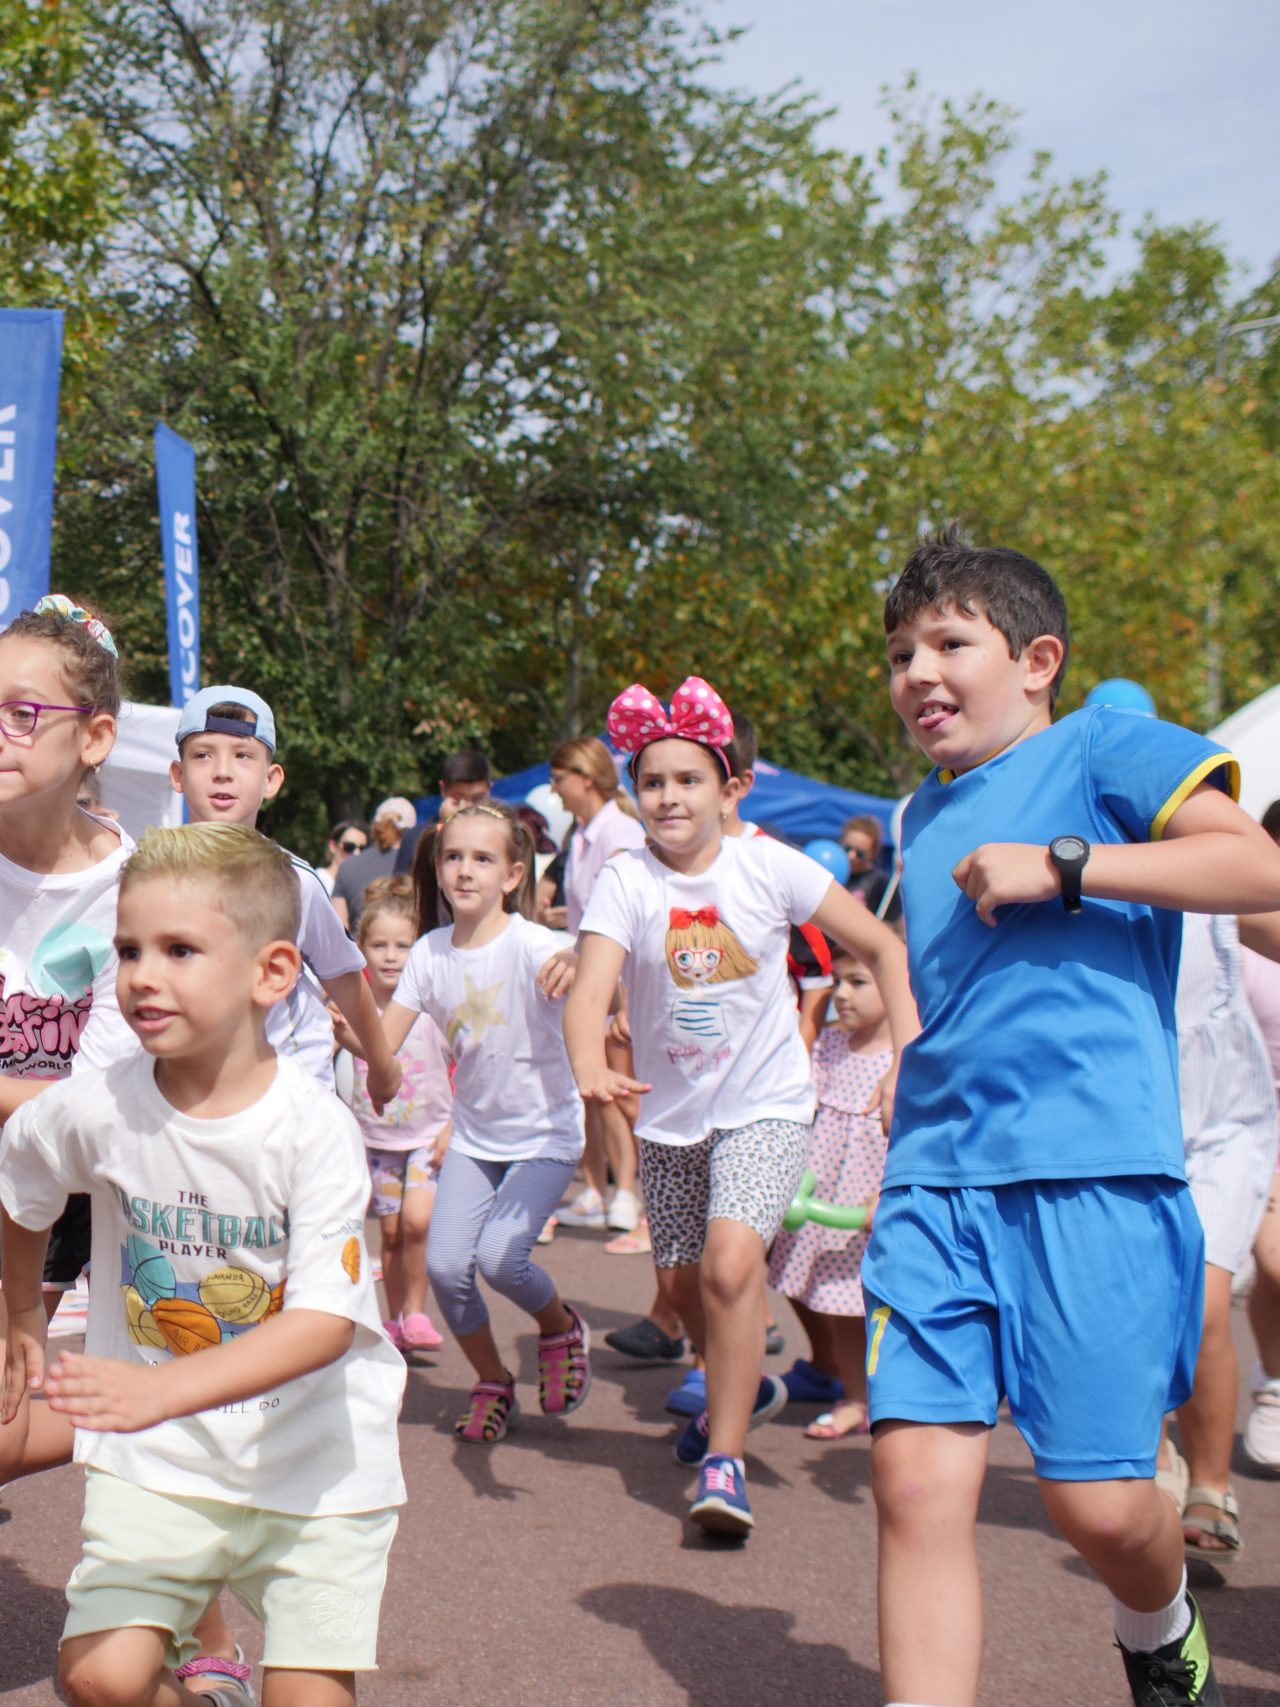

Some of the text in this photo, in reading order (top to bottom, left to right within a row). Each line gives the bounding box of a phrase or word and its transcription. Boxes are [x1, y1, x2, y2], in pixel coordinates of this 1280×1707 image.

[177, 1190, 209, 1208] THE
[108, 1181, 290, 1249] SKETBAL
[158, 1239, 227, 1260] PLAYER
[215, 1398, 280, 1414] ILL DO
